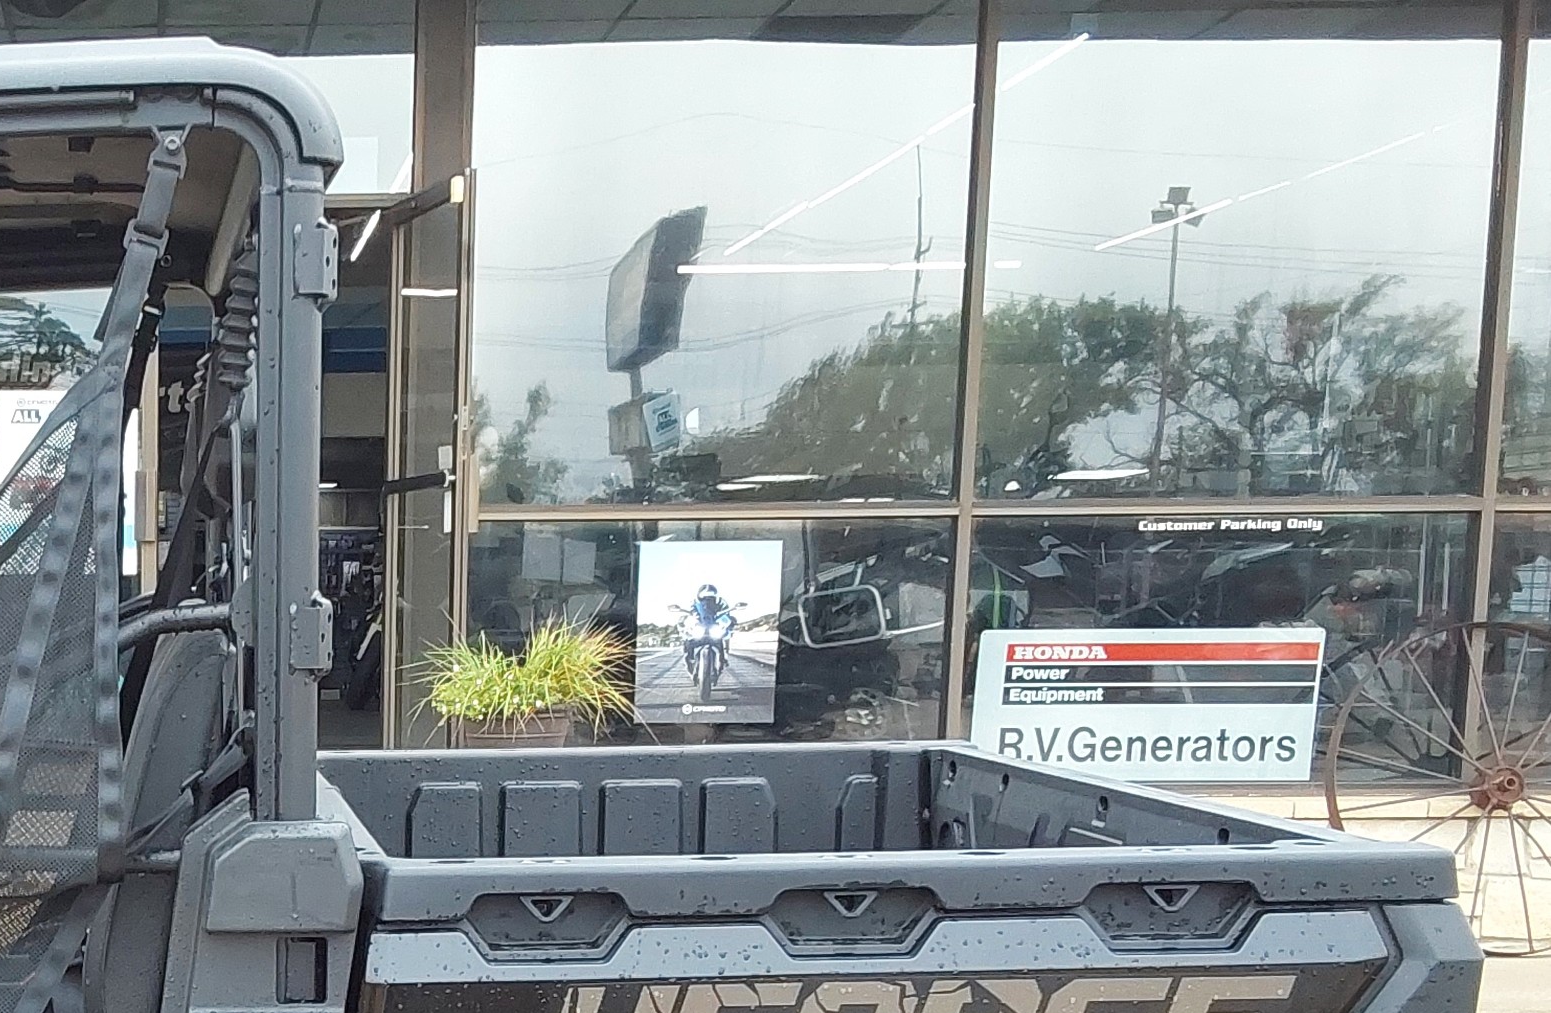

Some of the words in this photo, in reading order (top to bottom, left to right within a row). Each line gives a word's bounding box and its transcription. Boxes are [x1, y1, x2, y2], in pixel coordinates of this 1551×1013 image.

[11, 409, 41, 423] ALL
[1138, 520, 1215, 531] Customer
[1220, 519, 1281, 532] Parking
[1287, 518, 1323, 531] Only
[1012, 645, 1108, 660] HONDA
[1011, 666, 1070, 680] Power
[1009, 687, 1104, 704] Equipment
